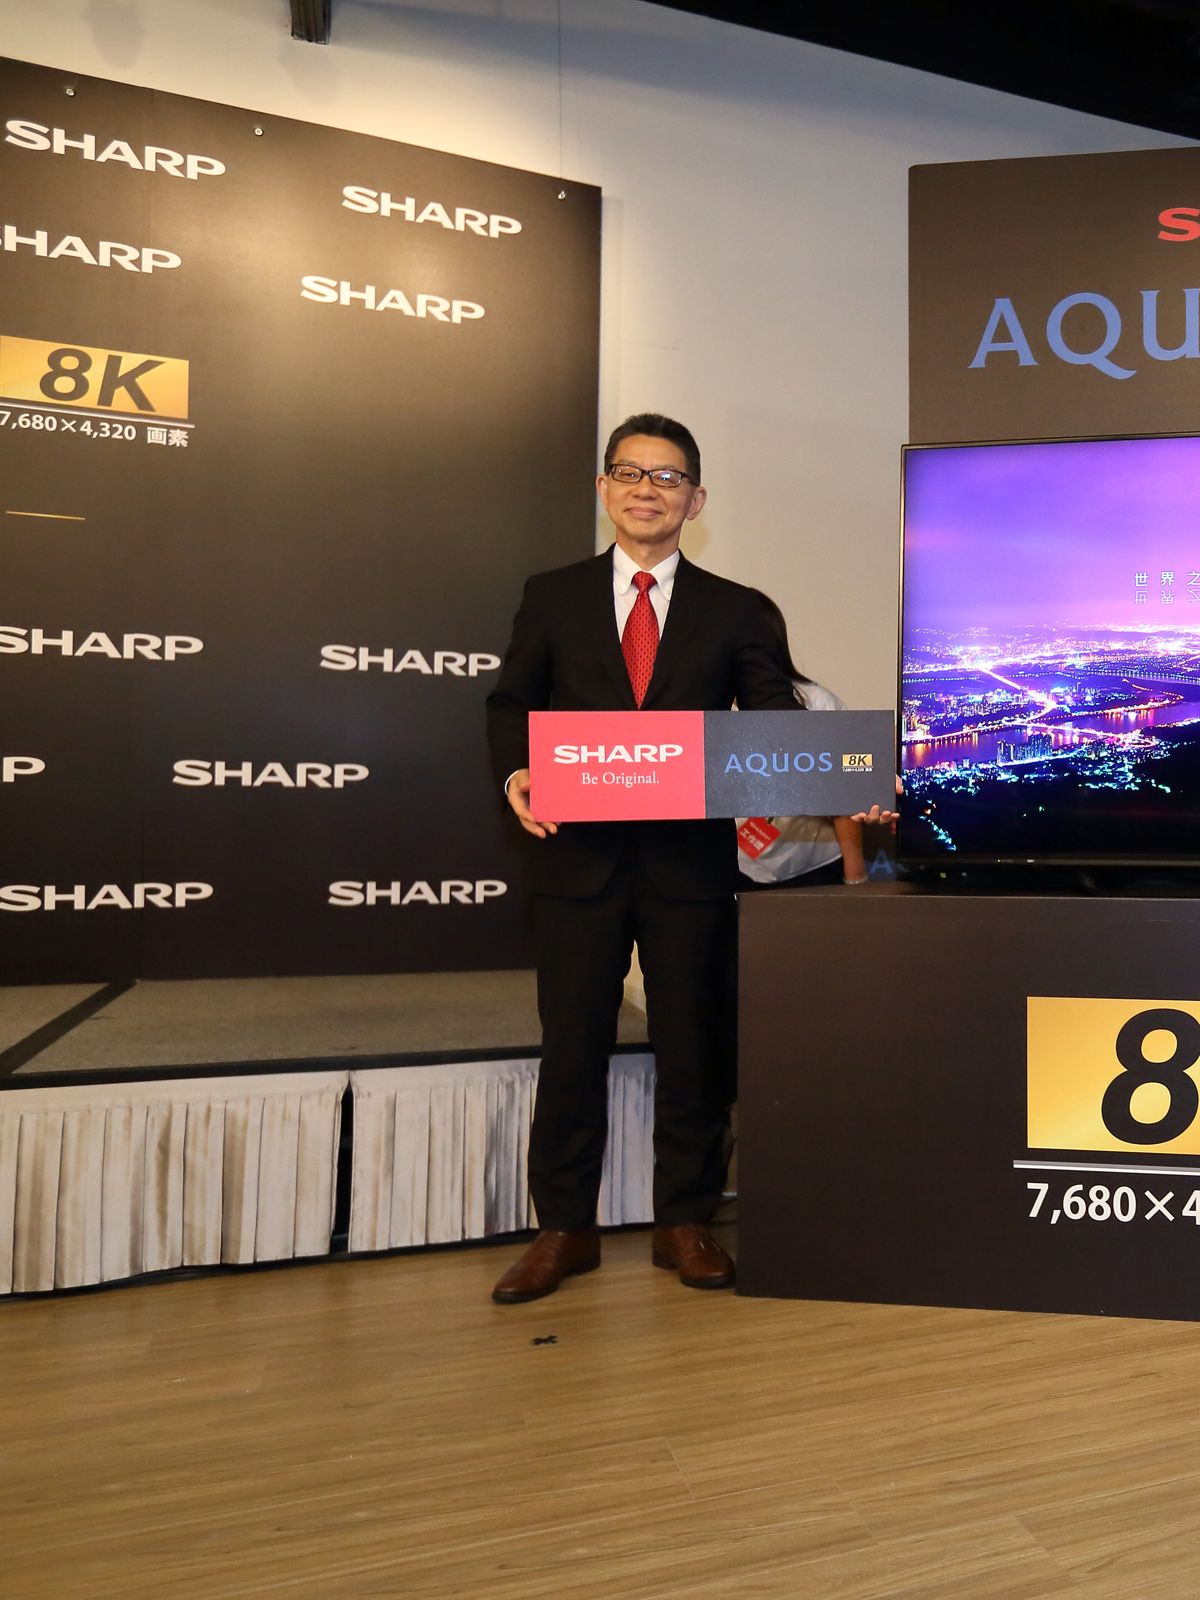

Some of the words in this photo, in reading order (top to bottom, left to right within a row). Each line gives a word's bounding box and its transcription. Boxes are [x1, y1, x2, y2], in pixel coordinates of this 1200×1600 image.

[5, 120, 227, 181] SHARP
[341, 185, 523, 239] SHARP
[0, 224, 182, 274] HARP
[300, 274, 486, 324] SHARP
[38, 347, 166, 413] 8K
[146, 426, 190, 449] 画素
[0, 625, 204, 661] SHARP
[320, 644, 501, 677] SHARP
[553, 743, 684, 765] SHARP
[723, 751, 834, 777] AQUOS
[848, 755, 868, 766] 8K
[172, 759, 370, 788] SHARP
[581, 771, 599, 785] Be
[602, 770, 660, 788] Original.
[0, 882, 214, 912] SHARP
[328, 880, 508, 906] SHARP
